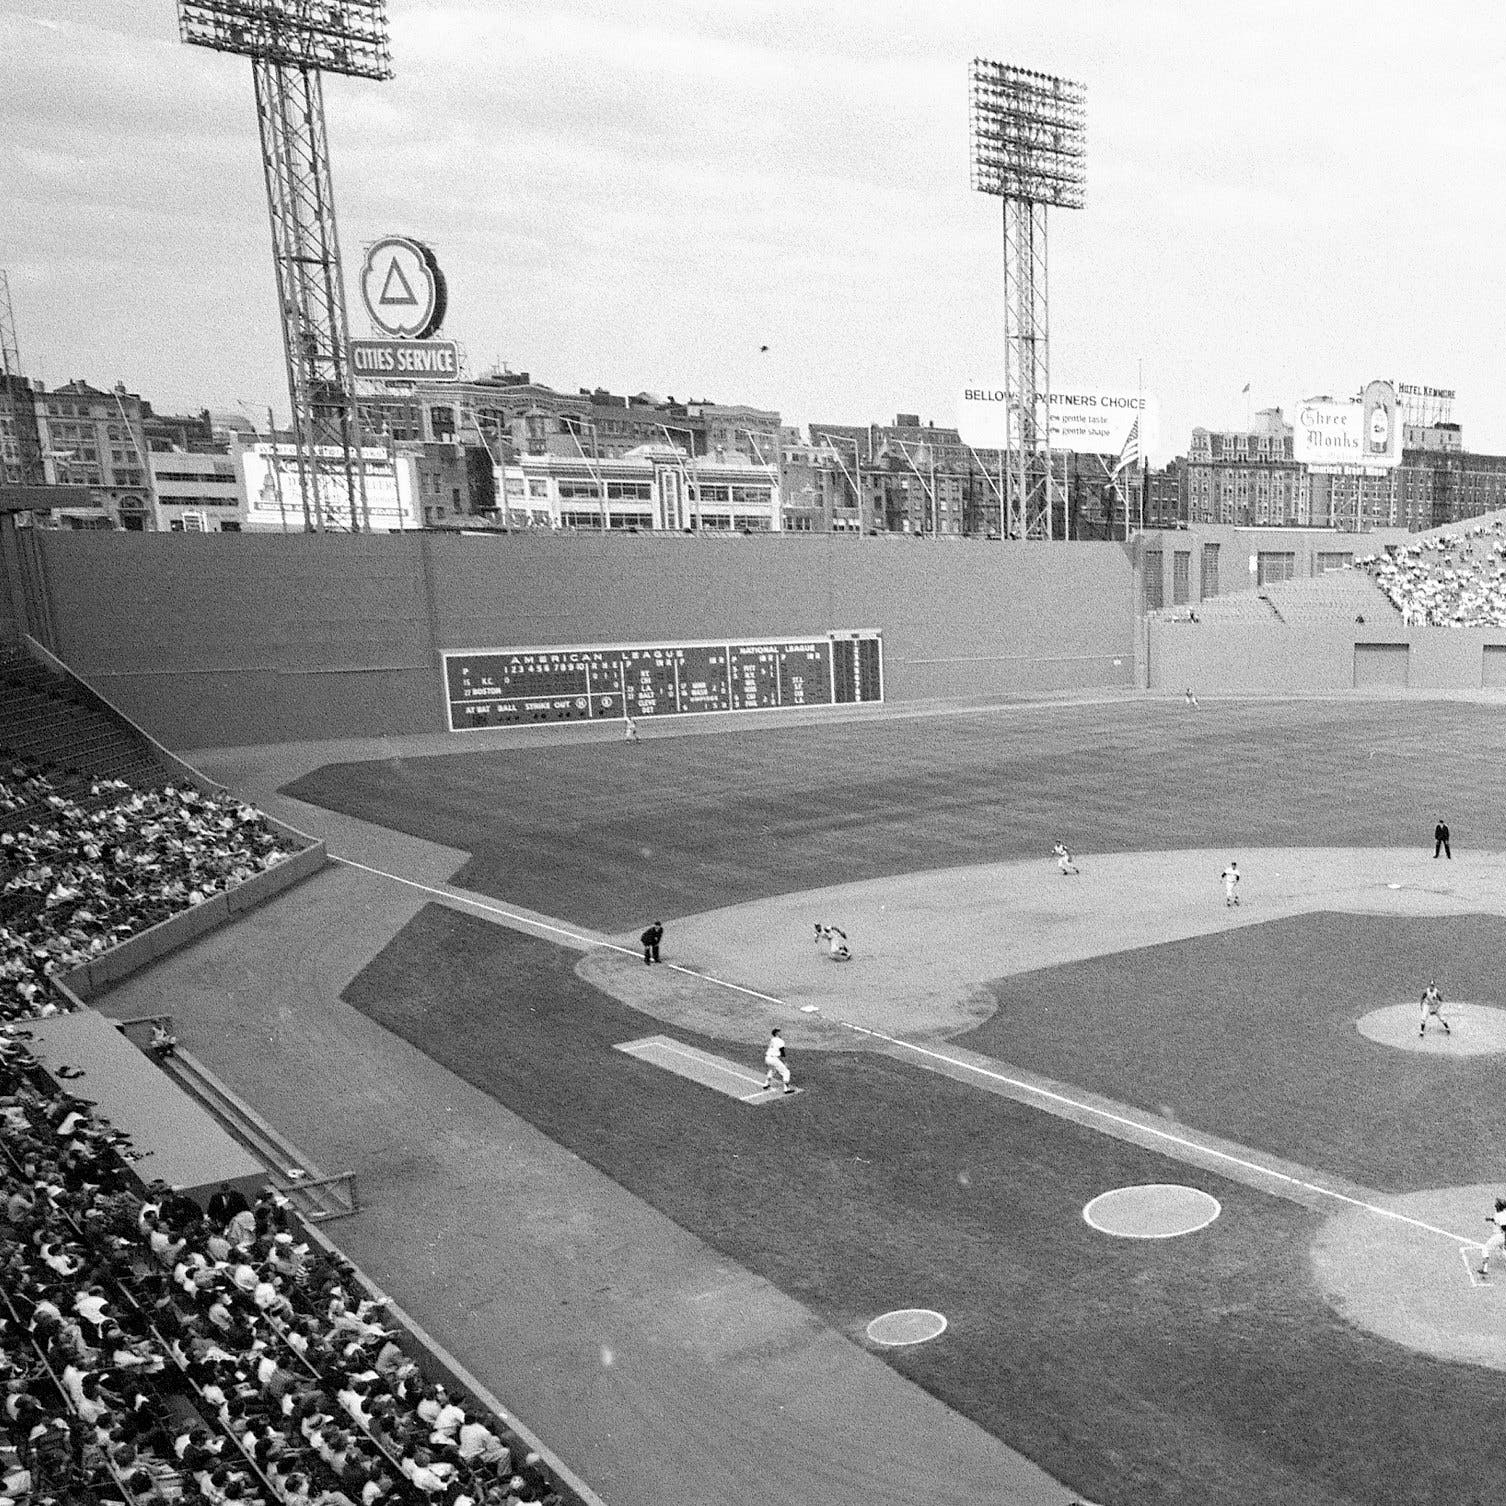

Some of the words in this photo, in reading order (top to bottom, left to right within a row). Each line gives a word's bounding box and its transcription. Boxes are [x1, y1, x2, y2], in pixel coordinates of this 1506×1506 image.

[354, 347, 395, 370] CITIES
[397, 348, 453, 372] SERVICE
[1398, 382, 1421, 395] HOTEL
[1423, 385, 1456, 399] KENMORE
[1101, 396, 1146, 409] CHOICE
[1062, 415, 1087, 424] gentle
[1088, 416, 1108, 424] taste
[1300, 407, 1348, 426] Three
[1062, 427, 1086, 435] gentle
[1088, 428, 1110, 437] shape
[1306, 430, 1359, 449] Monks
[739, 646, 779, 654] NATIONAL
[785, 644, 815, 652] LEAGUE
[510, 653, 603, 664] AMERICAN
[622, 650, 684, 660] LEAGUE
[472, 687, 502, 696] BOSTON
[497, 704, 517, 712] BALL
[553, 700, 571, 709] OUT
